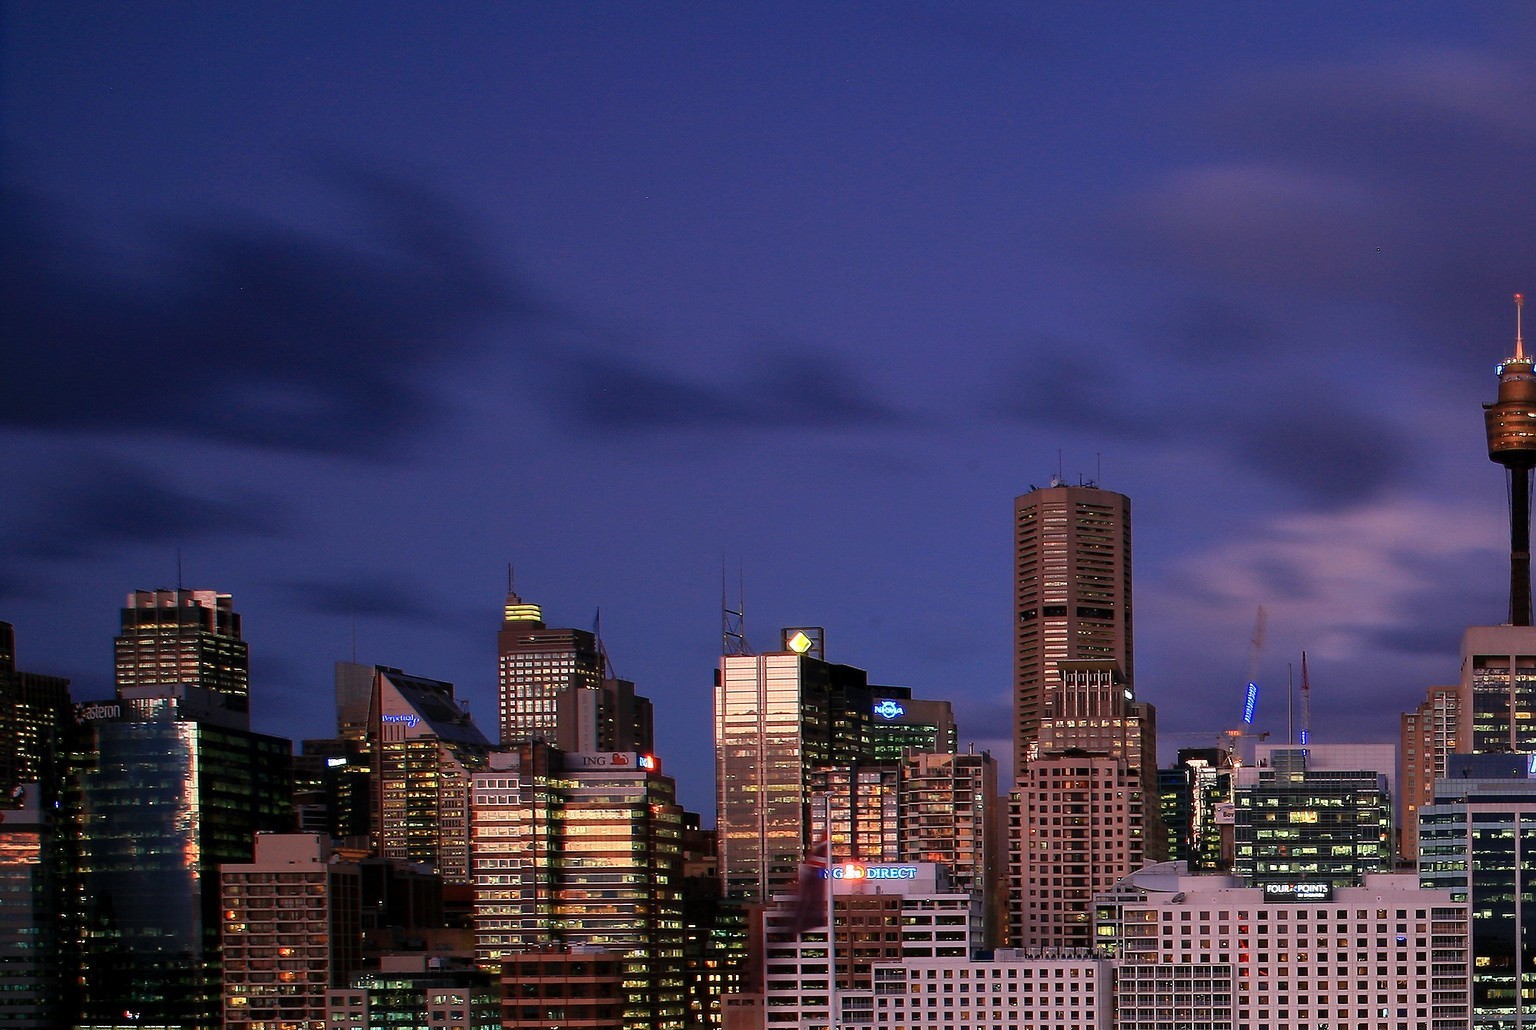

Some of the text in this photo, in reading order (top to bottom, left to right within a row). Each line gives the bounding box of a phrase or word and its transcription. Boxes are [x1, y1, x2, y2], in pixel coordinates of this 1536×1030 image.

[85, 704, 120, 720] asteron
[582, 756, 606, 766] ING
[866, 868, 916, 879] DIRECT
[1266, 884, 1328, 893] FOUR POINTS
